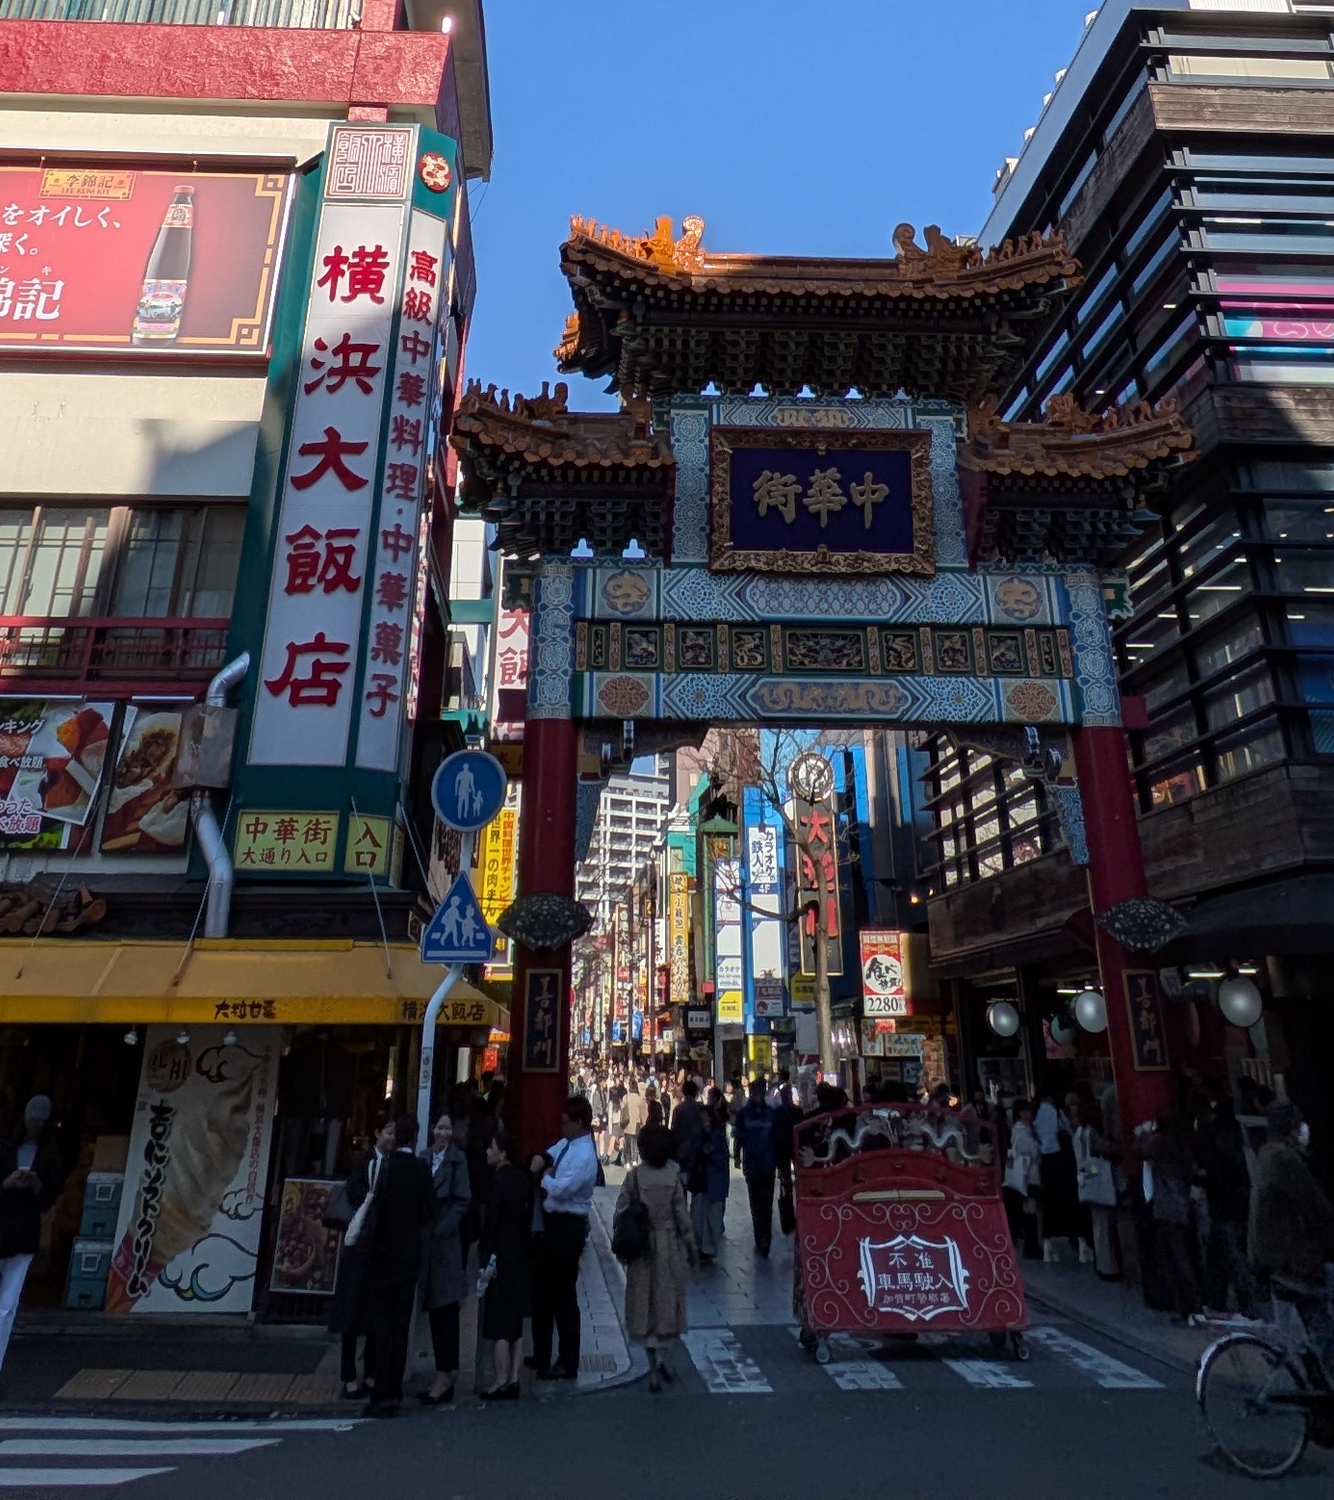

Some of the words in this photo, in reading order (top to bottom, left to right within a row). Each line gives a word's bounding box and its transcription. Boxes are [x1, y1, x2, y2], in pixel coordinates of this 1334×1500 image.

[264, 243, 391, 709] 横浜大飯店
[244, 816, 333, 847] 中華街
[352, 822, 383, 869] 入口
[240, 846, 329, 867] 大通り入口
[867, 996, 899, 1012] 2280
